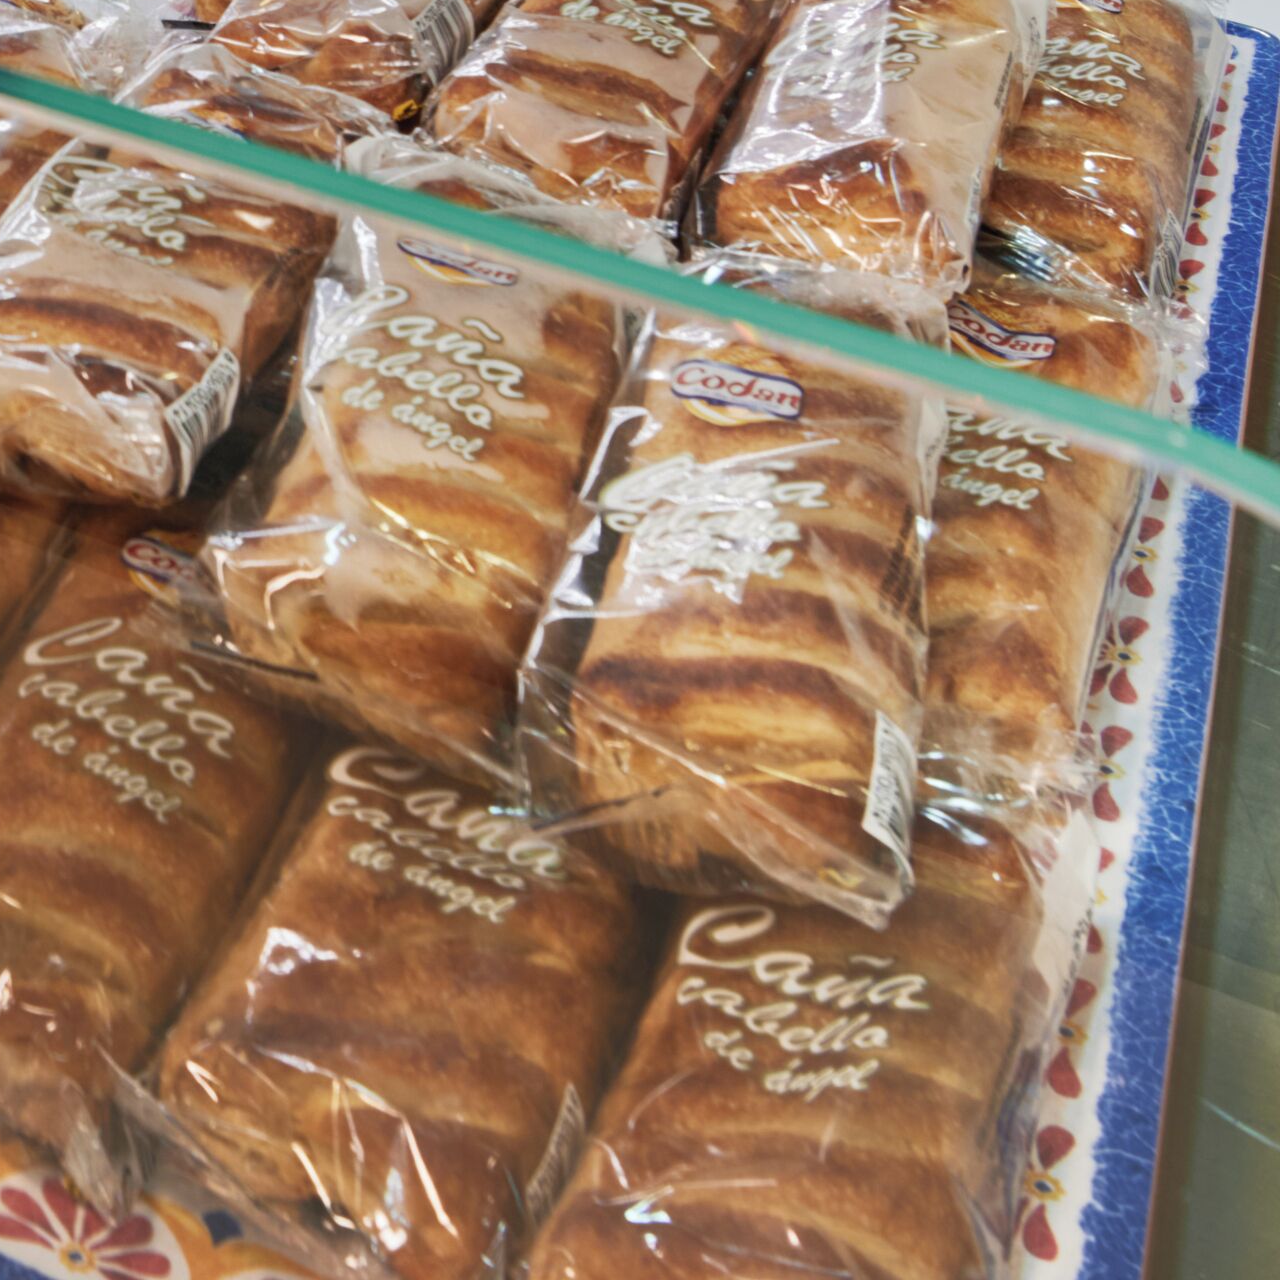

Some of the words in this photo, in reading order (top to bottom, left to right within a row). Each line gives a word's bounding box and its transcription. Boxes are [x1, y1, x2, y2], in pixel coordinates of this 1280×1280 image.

[341, 378, 384, 411] de
[392, 395, 485, 462] ángel
[675, 365, 802, 414] Codan
[18, 673, 196, 787] cabello
[23, 617, 236, 760] Caña
[30, 719, 77, 756] de
[82, 743, 183, 824] ángel
[348, 839, 395, 872] de
[403, 862, 518, 924] ángel
[676, 903, 932, 1011] Caña
[675, 975, 889, 1055] cabello
[703, 1029, 755, 1071] de
[762, 1057, 881, 1104] ángel
